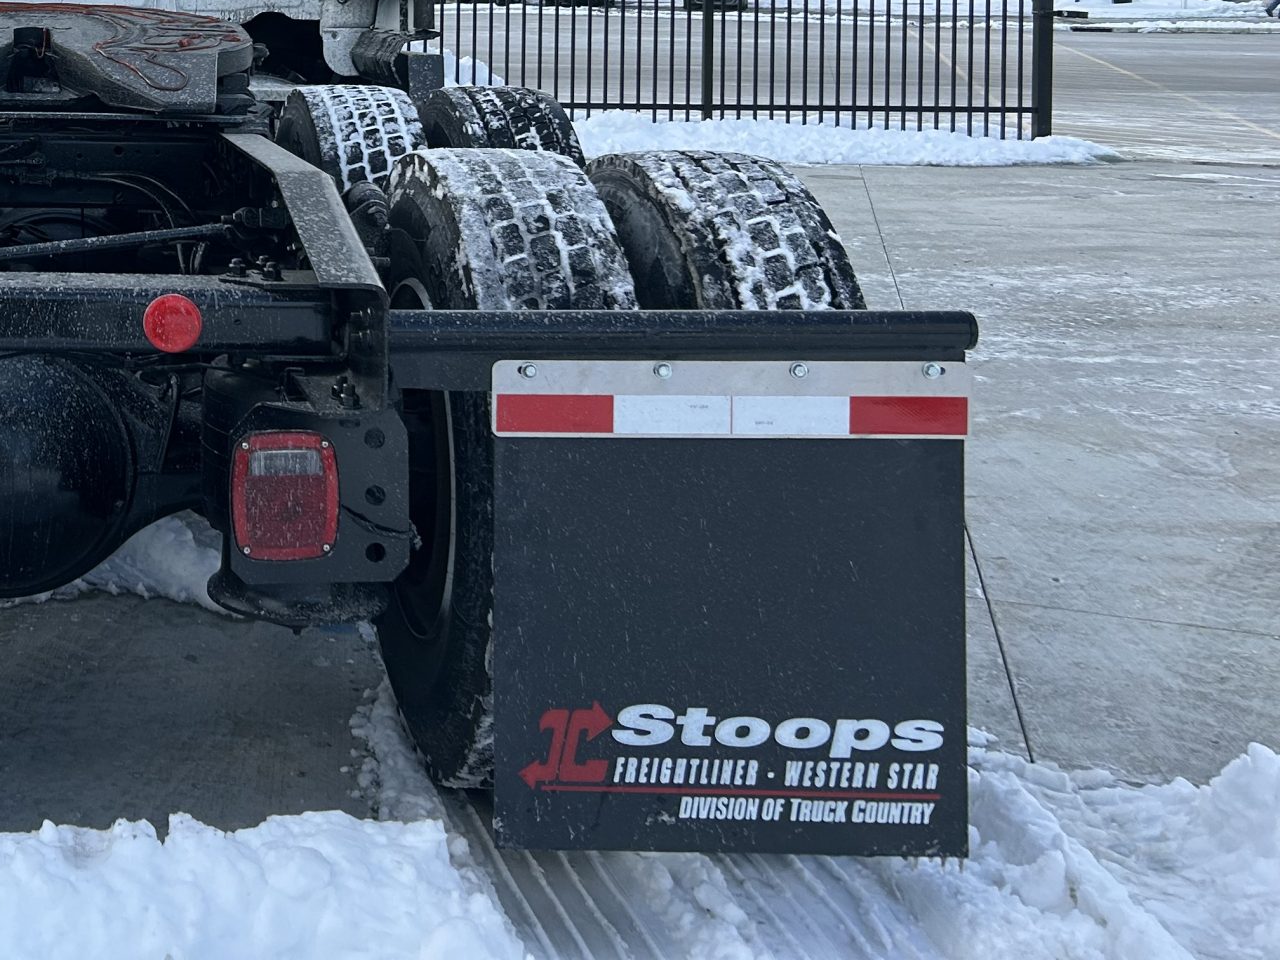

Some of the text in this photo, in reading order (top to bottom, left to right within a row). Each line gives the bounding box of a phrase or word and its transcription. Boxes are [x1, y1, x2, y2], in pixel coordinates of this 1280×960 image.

[611, 703, 945, 759] Stoops
[613, 756, 759, 786] FREIGHTLINER
[784, 760, 880, 789] WESTERN
[887, 762, 939, 790] STAR
[678, 796, 936, 825] DIVISION OF TRUCK COUNTRY
